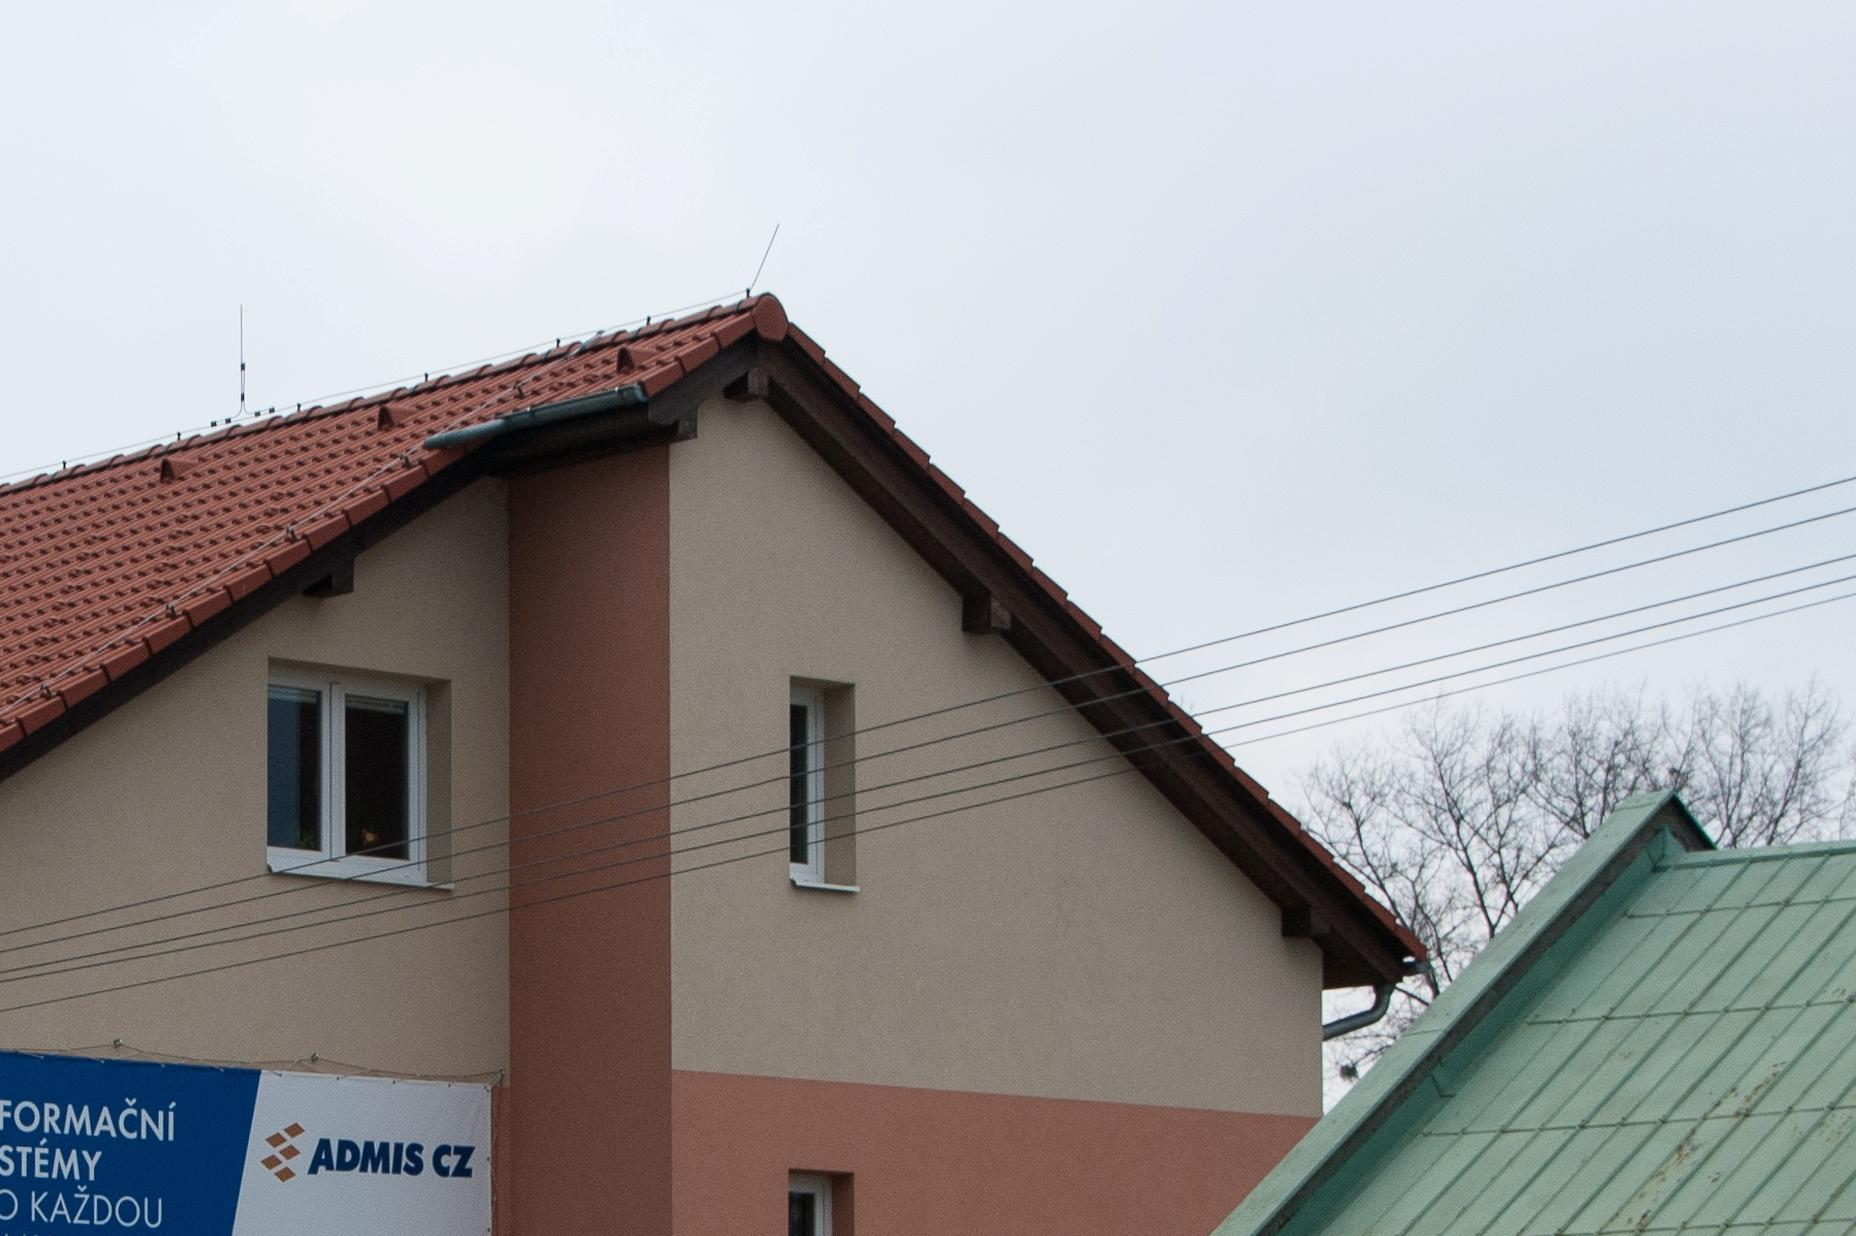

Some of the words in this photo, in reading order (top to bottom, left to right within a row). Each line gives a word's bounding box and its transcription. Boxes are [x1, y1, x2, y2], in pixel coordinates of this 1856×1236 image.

[307, 1137, 425, 1177] ADMIS
[431, 1144, 476, 1178] CZ
[31, 1184, 163, 1229] KAŽDOU
